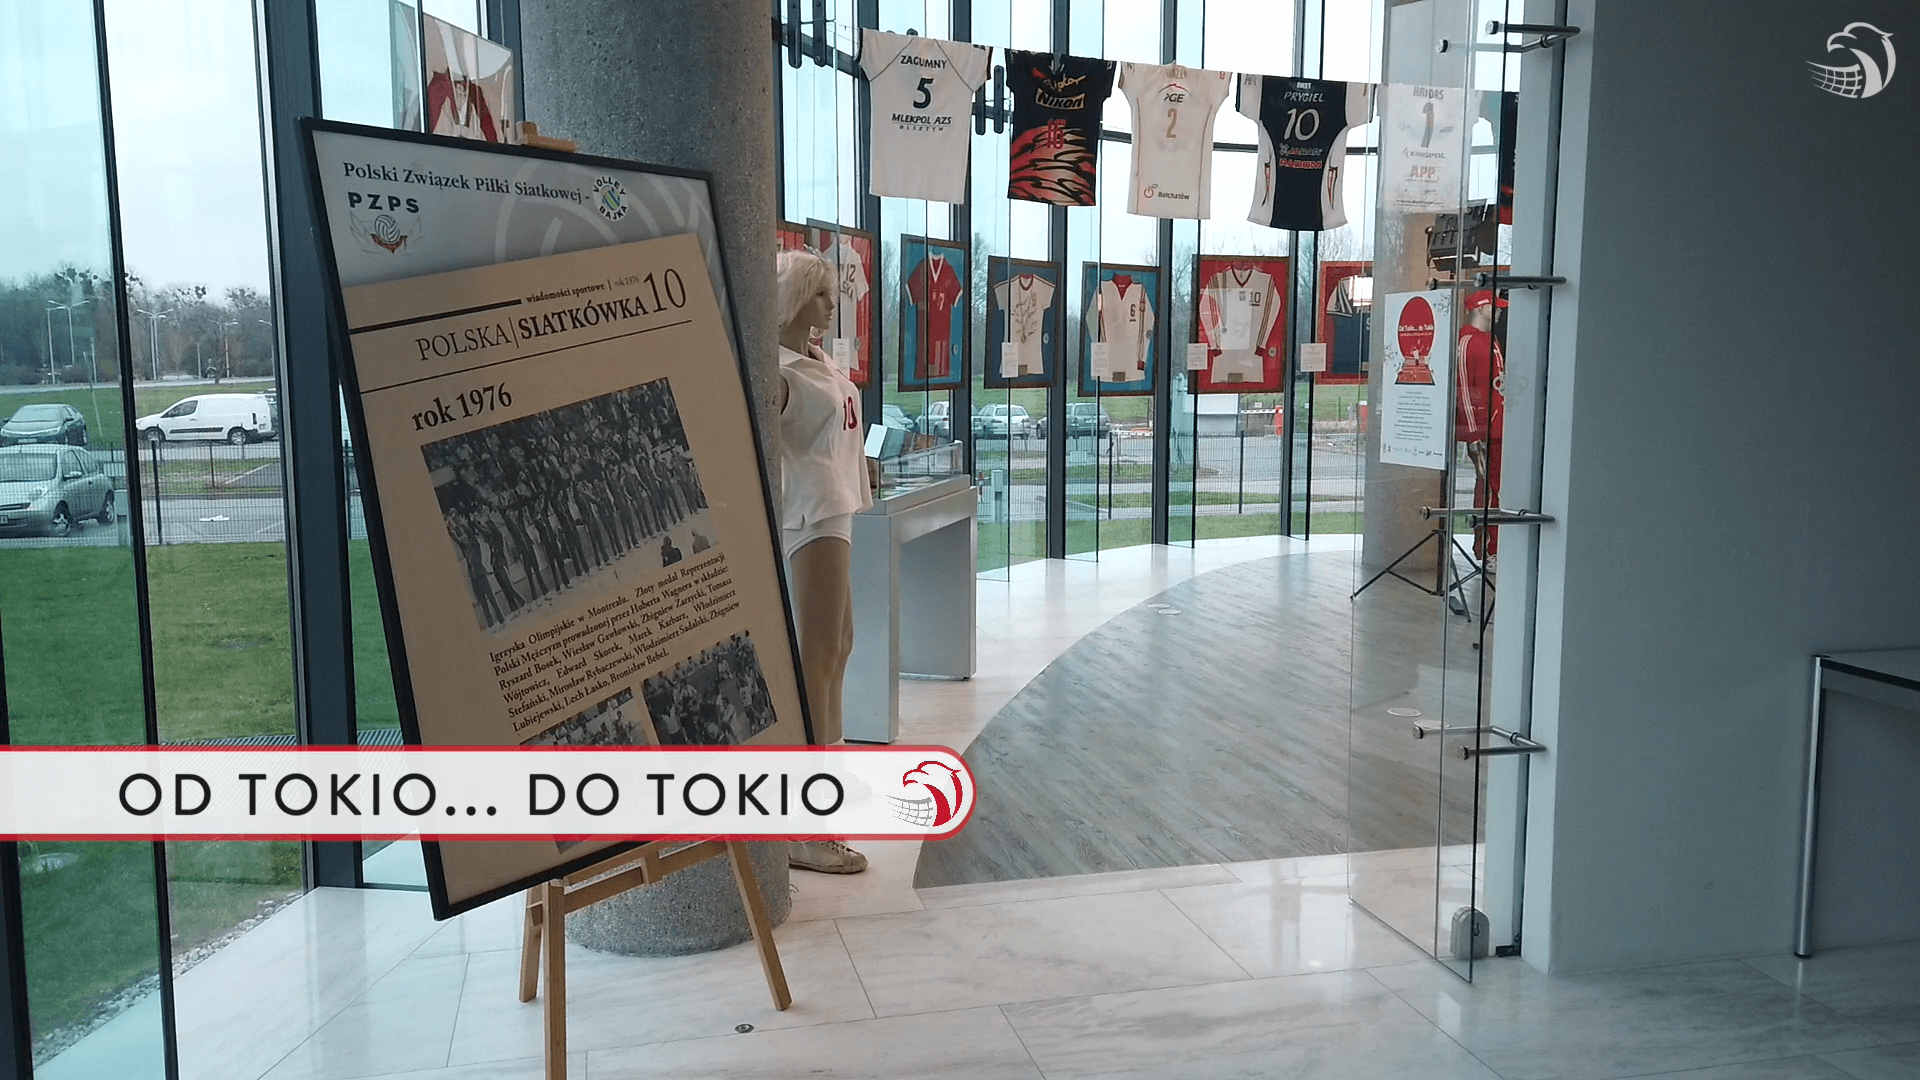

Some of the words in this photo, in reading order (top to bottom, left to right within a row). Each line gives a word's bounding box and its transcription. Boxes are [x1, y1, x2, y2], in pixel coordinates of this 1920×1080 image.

[900, 55, 948, 69] ZAGUMNY
[913, 78, 934, 109] 5
[1284, 91, 1324, 103] PRYGIEL
[891, 113, 931, 125] MLEKPOL
[934, 116, 952, 125] AZS
[1047, 118, 1067, 149] 16
[1166, 108, 1177, 138] 2
[1284, 108, 1320, 141] 10
[1423, 102, 1434, 148] 1
[343, 162, 399, 182] Polski
[403, 168, 471, 190] Związek
[474, 177, 510, 194] Piłki
[514, 181, 582, 204] Siatkowej
[593, 176, 626, 195] VOLLEY
[347, 191, 420, 213] PZPS
[526, 287, 571, 303] wiadomości
[572, 282, 605, 298] sportowe
[1250, 291, 1261, 304] 10
[415, 323, 512, 361] POLSKA
[518, 296, 649, 340] SIATKÓWKA
[643, 268, 687, 313] 10
[1130, 304, 1136, 317] 6
[412, 397, 456, 431] rok
[456, 382, 513, 419] 1976
[842, 396, 858, 431] 10
[489, 641, 526, 663] Igrzyska
[528, 619, 576, 645] Olimpijskie
[577, 615, 585, 623] w
[635, 585, 654, 598] Złoty
[658, 572, 678, 588] medal
[680, 552, 725, 578] Reprezentacji
[494, 658, 521, 676] Polski
[521, 641, 562, 665] Mężczyzn
[562, 619, 611, 647] prowadzonej
[610, 609, 630, 626] przez
[630, 596, 660, 614] Huberta
[661, 582, 692, 599] Wagnera
[499, 668, 533, 691] Ryszard
[534, 655, 562, 674] Bosek,
[562, 638, 597, 660] Wiesław
[597, 619, 640, 644] Gawłowski,
[641, 605, 674, 624] Zbigniew
[706, 578, 733, 593] Tomasz
[503, 678, 551, 704] Wójtowicz,
[556, 657, 587, 679] Edward
[593, 642, 623, 661] Skorek,
[628, 627, 653, 644] Marek
[693, 589, 736, 613] Włodzimierz
[508, 692, 550, 718] Stefański,
[548, 673, 585, 699] Mirosław
[585, 652, 635, 682] Rybaczewski,
[634, 629, 679, 656] Włodzimierz
[709, 602, 740, 620] Zbigniew
[512, 700, 565, 733] Lubiejewski,
[563, 690, 585, 706] Lech
[584, 677, 611, 696] Łasko,
[609, 659, 646, 684] Bronisław
